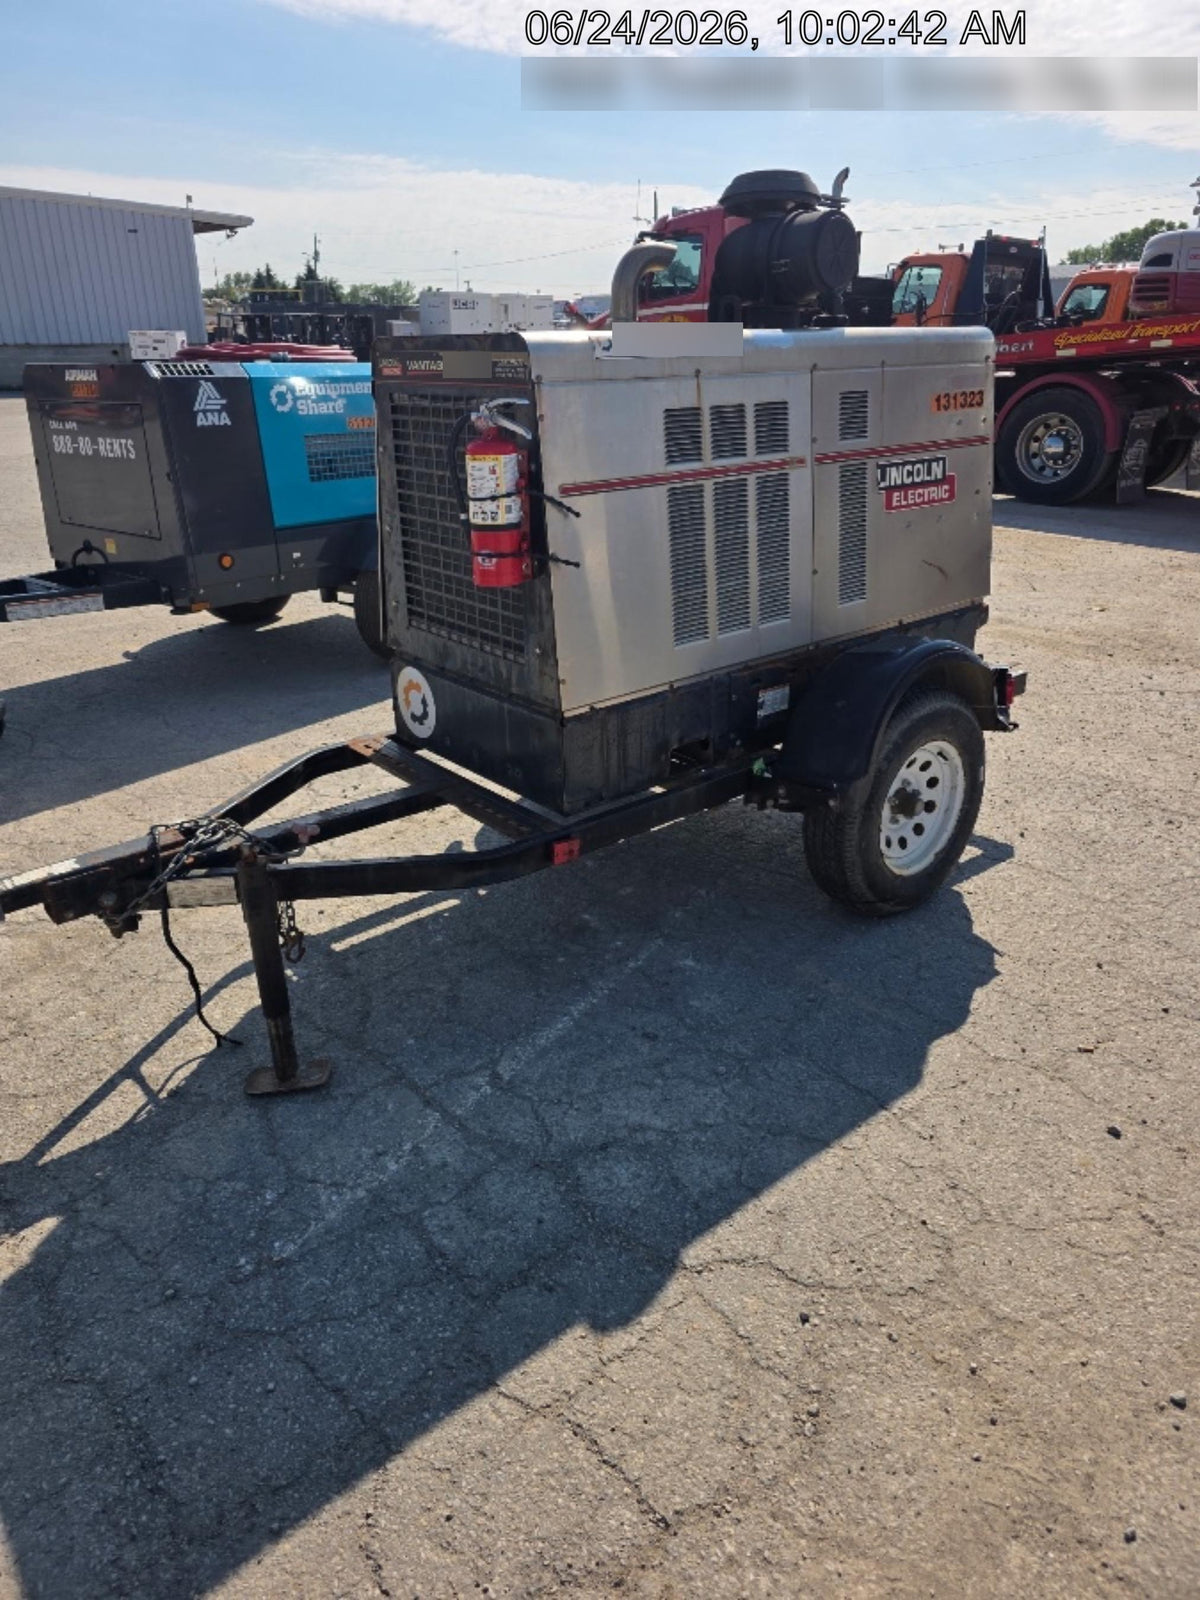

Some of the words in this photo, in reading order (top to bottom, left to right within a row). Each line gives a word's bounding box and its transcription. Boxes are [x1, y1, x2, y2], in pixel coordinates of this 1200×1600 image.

[295, 381, 372, 399] Equipmen
[935, 390, 985, 412] 131323
[197, 411, 232, 427] ANA
[877, 460, 944, 488] LINCOLN
[892, 484, 951, 507] ELECTRIC
